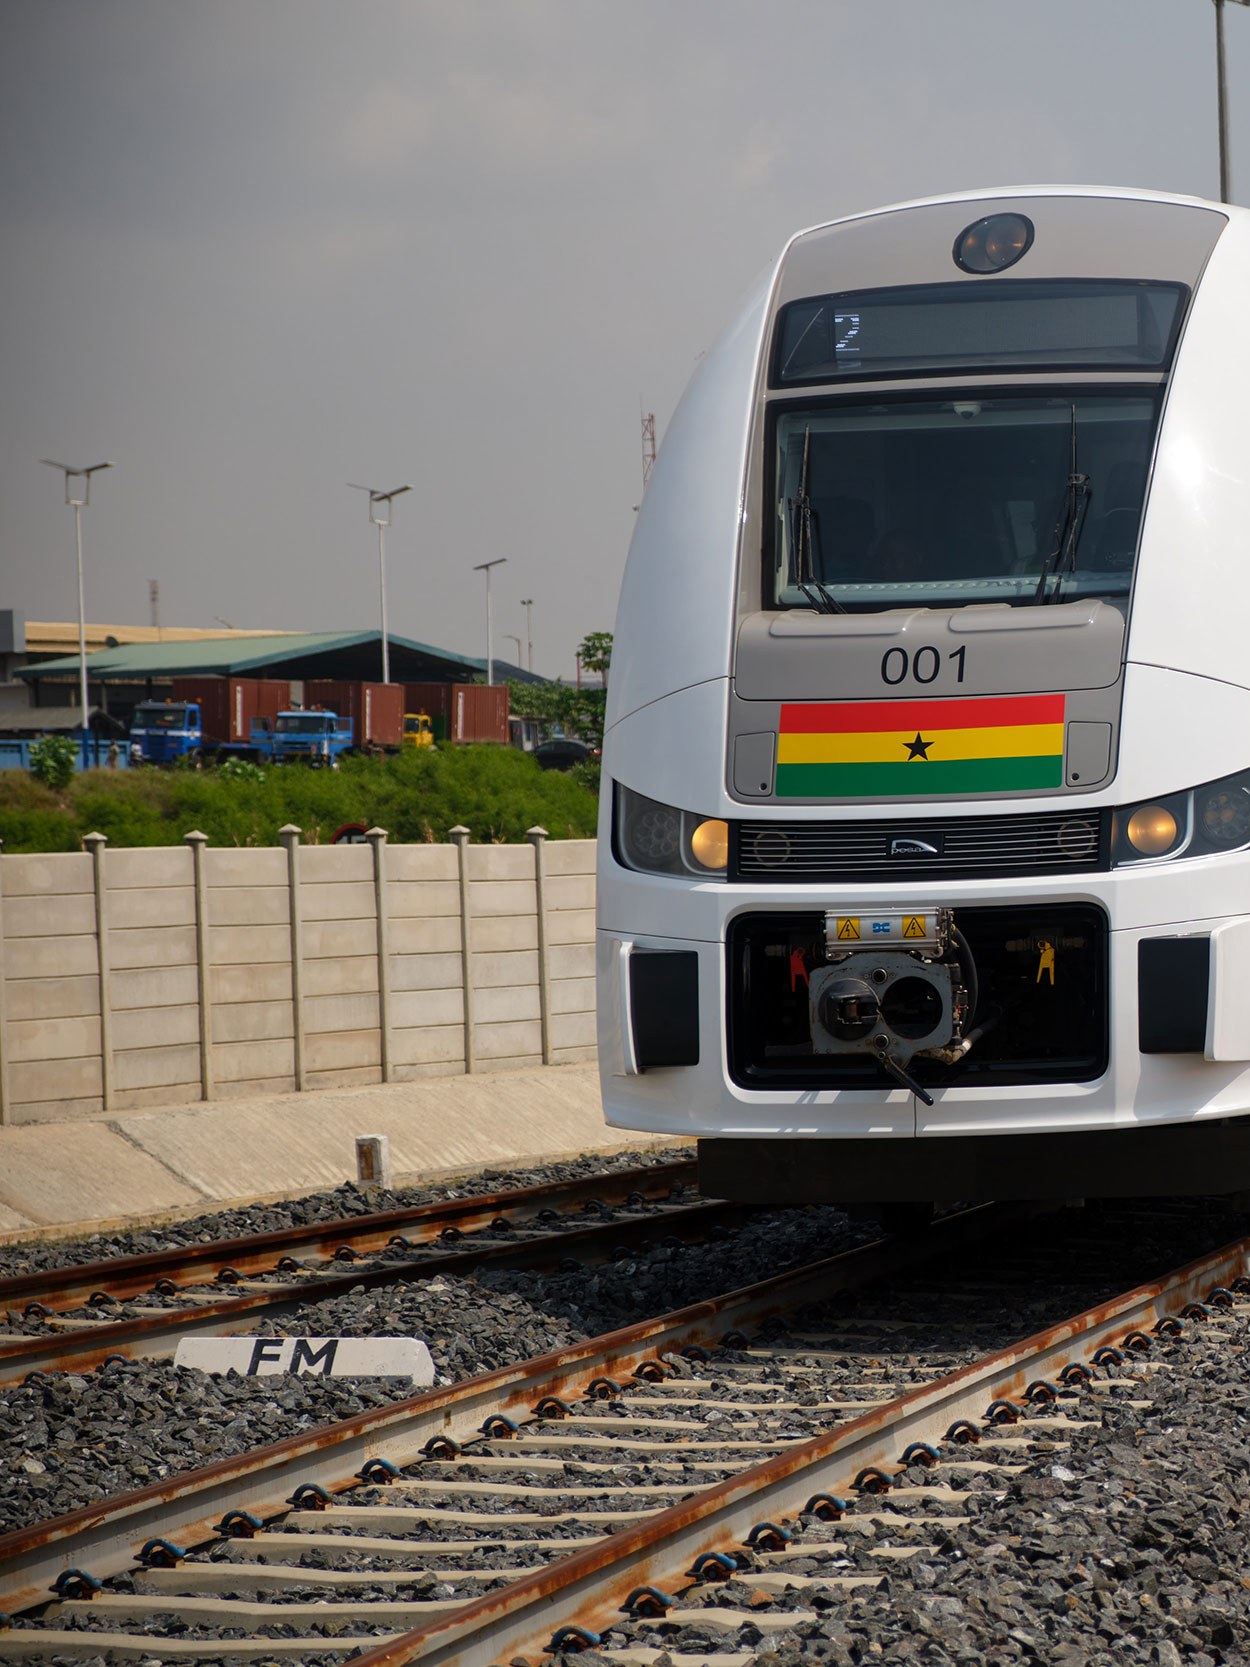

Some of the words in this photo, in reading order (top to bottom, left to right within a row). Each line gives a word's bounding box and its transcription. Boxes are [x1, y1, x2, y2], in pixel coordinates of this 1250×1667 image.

[834, 314, 860, 351] 2
[881, 645, 966, 685] 001
[246, 1338, 339, 1377] FM
